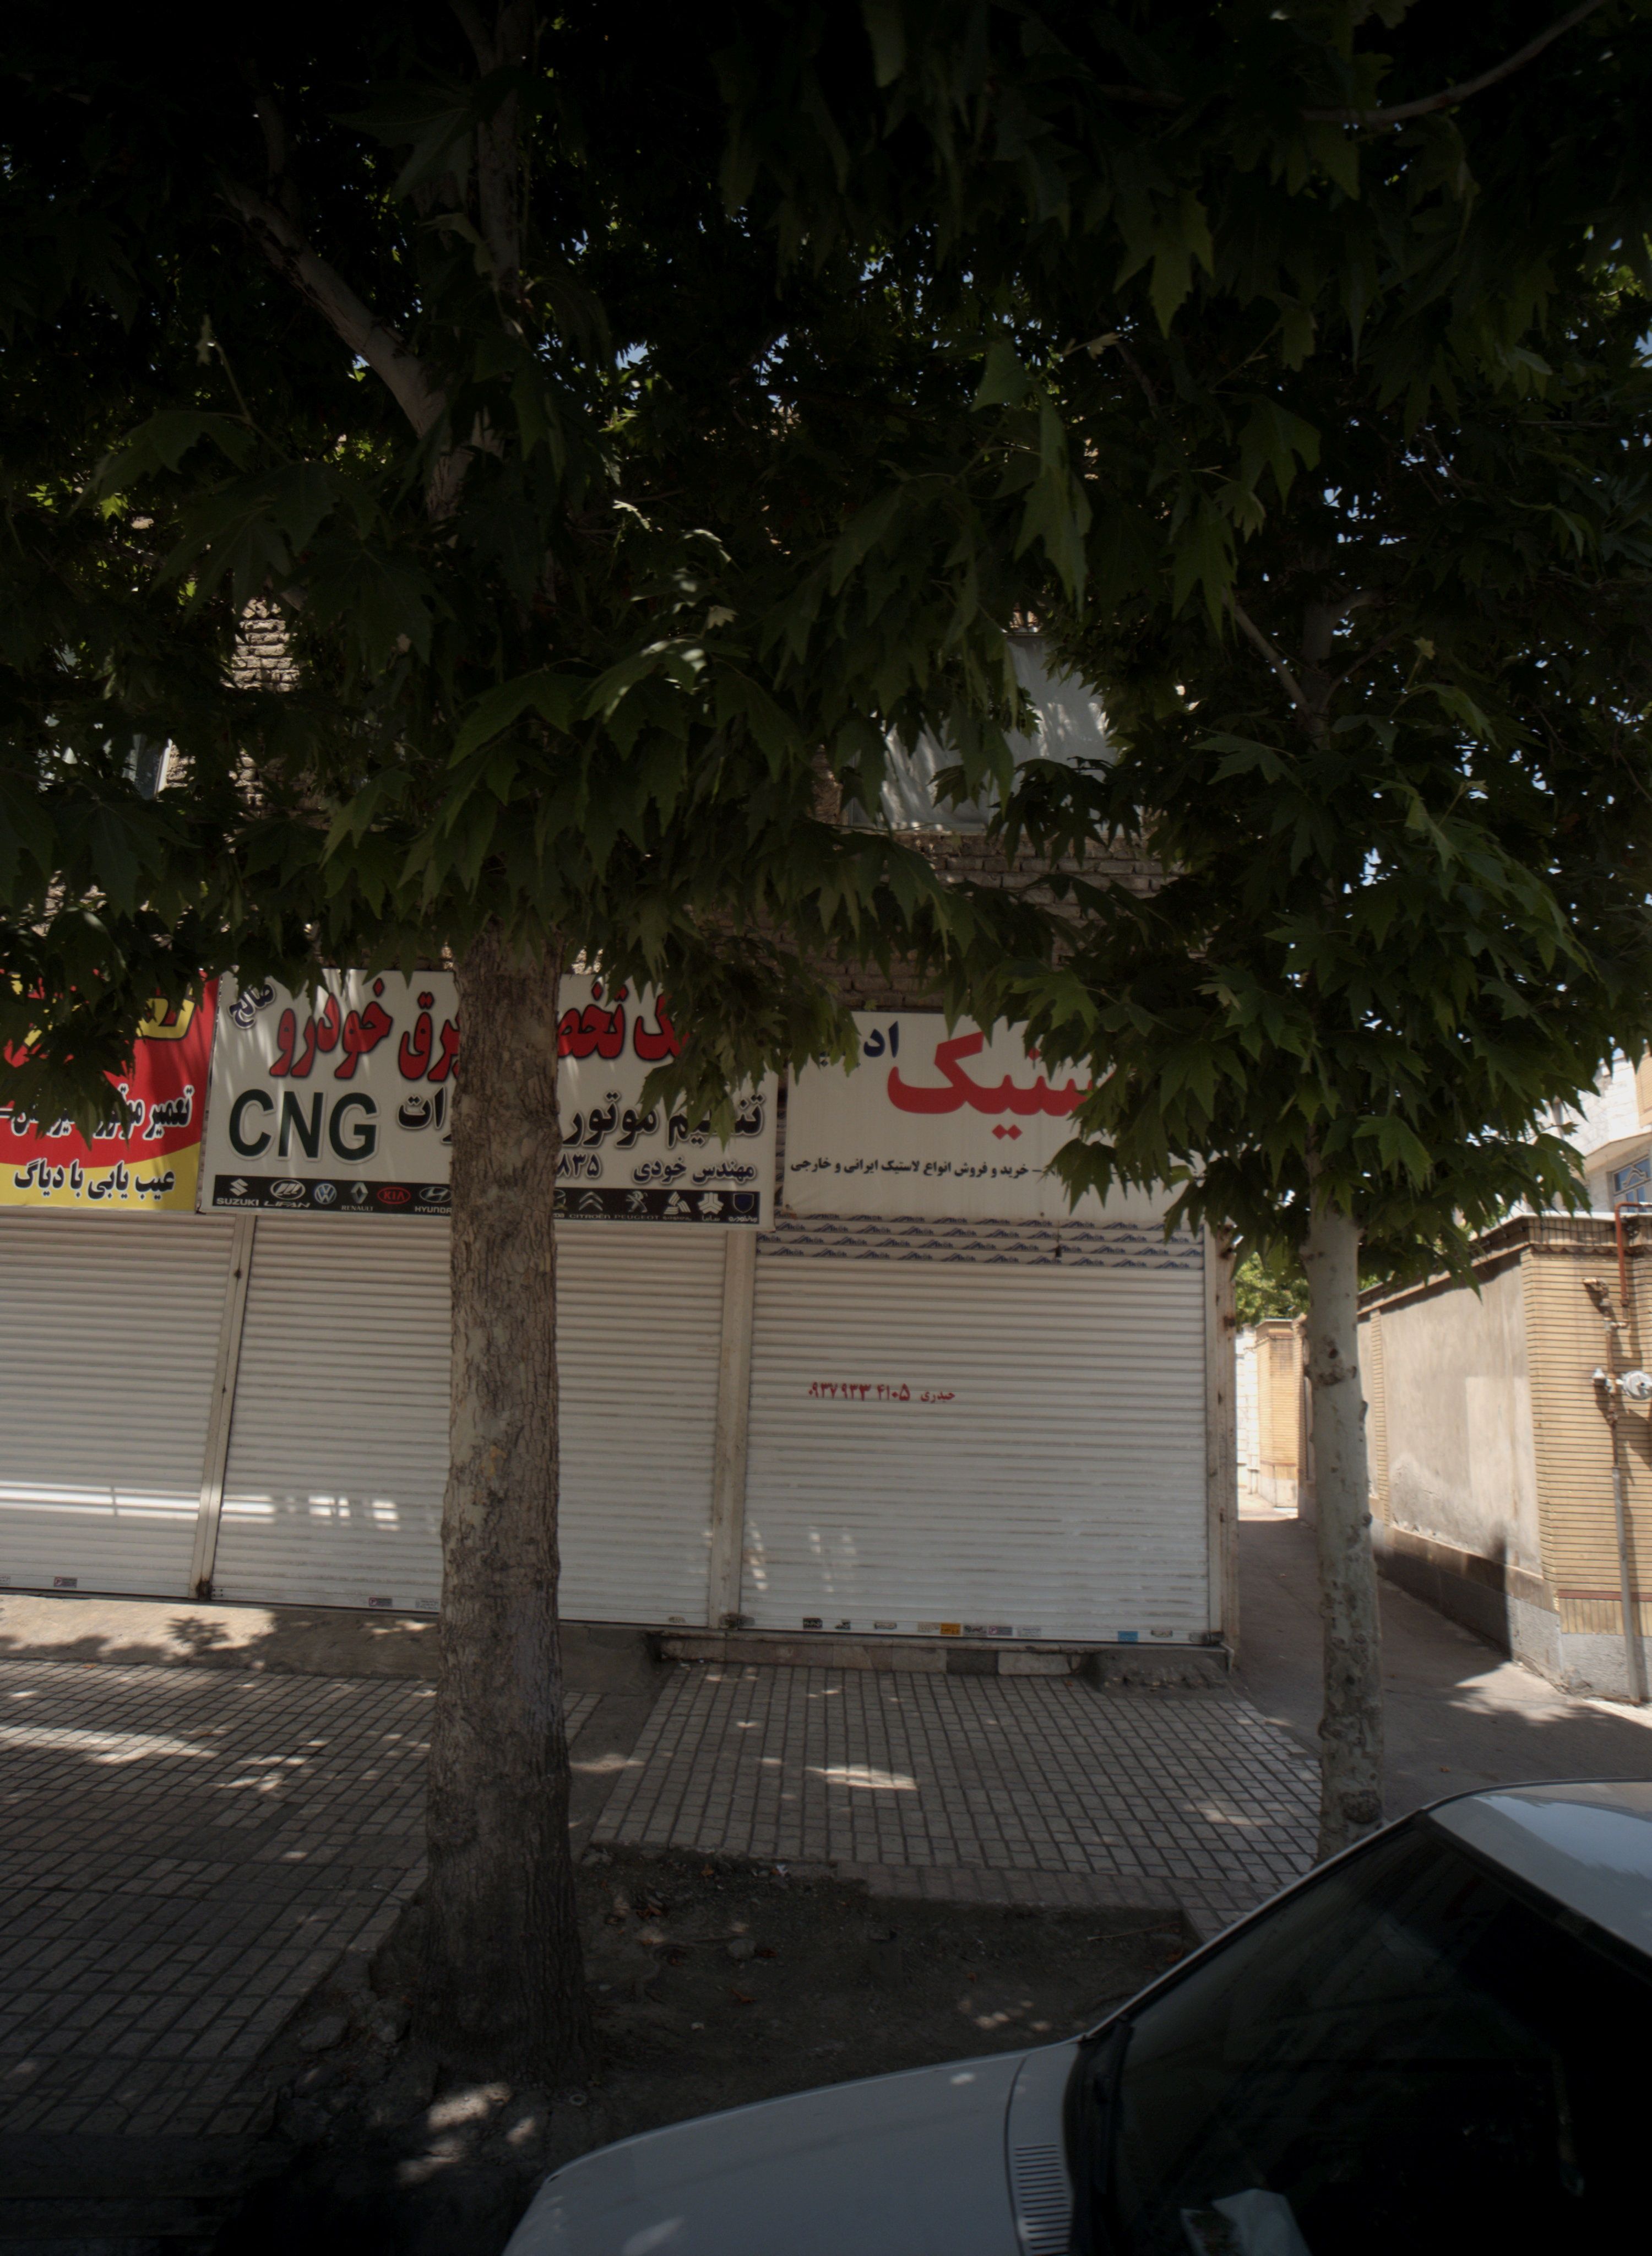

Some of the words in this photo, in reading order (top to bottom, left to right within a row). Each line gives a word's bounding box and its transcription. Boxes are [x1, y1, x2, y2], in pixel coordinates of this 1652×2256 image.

[269, 978, 393, 1078] خودرو
[144, 1086, 194, 1138] تعمیر
[561, 1091, 659, 1147] موتور
[229, 1088, 378, 1161] CNG
[693, 1160, 756, 1183] مهندس
[790, 1157, 832, 1173] خارجی
[833, 1163, 841, 1174] و
[844, 1159, 879, 1174] ایرانی
[881, 1160, 920, 1173] لاستیک
[923, 1162, 952, 1176] انواع
[954, 1162, 988, 1178] فروش
[991, 1167, 998, 1178] و
[1000, 1163, 1029, 1179] خرید
[14, 1158, 64, 1197] دیاگ
[70, 1159, 83, 1198] با
[88, 1162, 128, 1200] یابی
[135, 1171, 175, 1200] عیب
[216, 1197, 259, 1206] SUZUKI
[341, 1205, 373, 1213] RENAULT
[383, 1190, 405, 1201] KIA
[414, 1205, 452, 1214] HYUNDA
